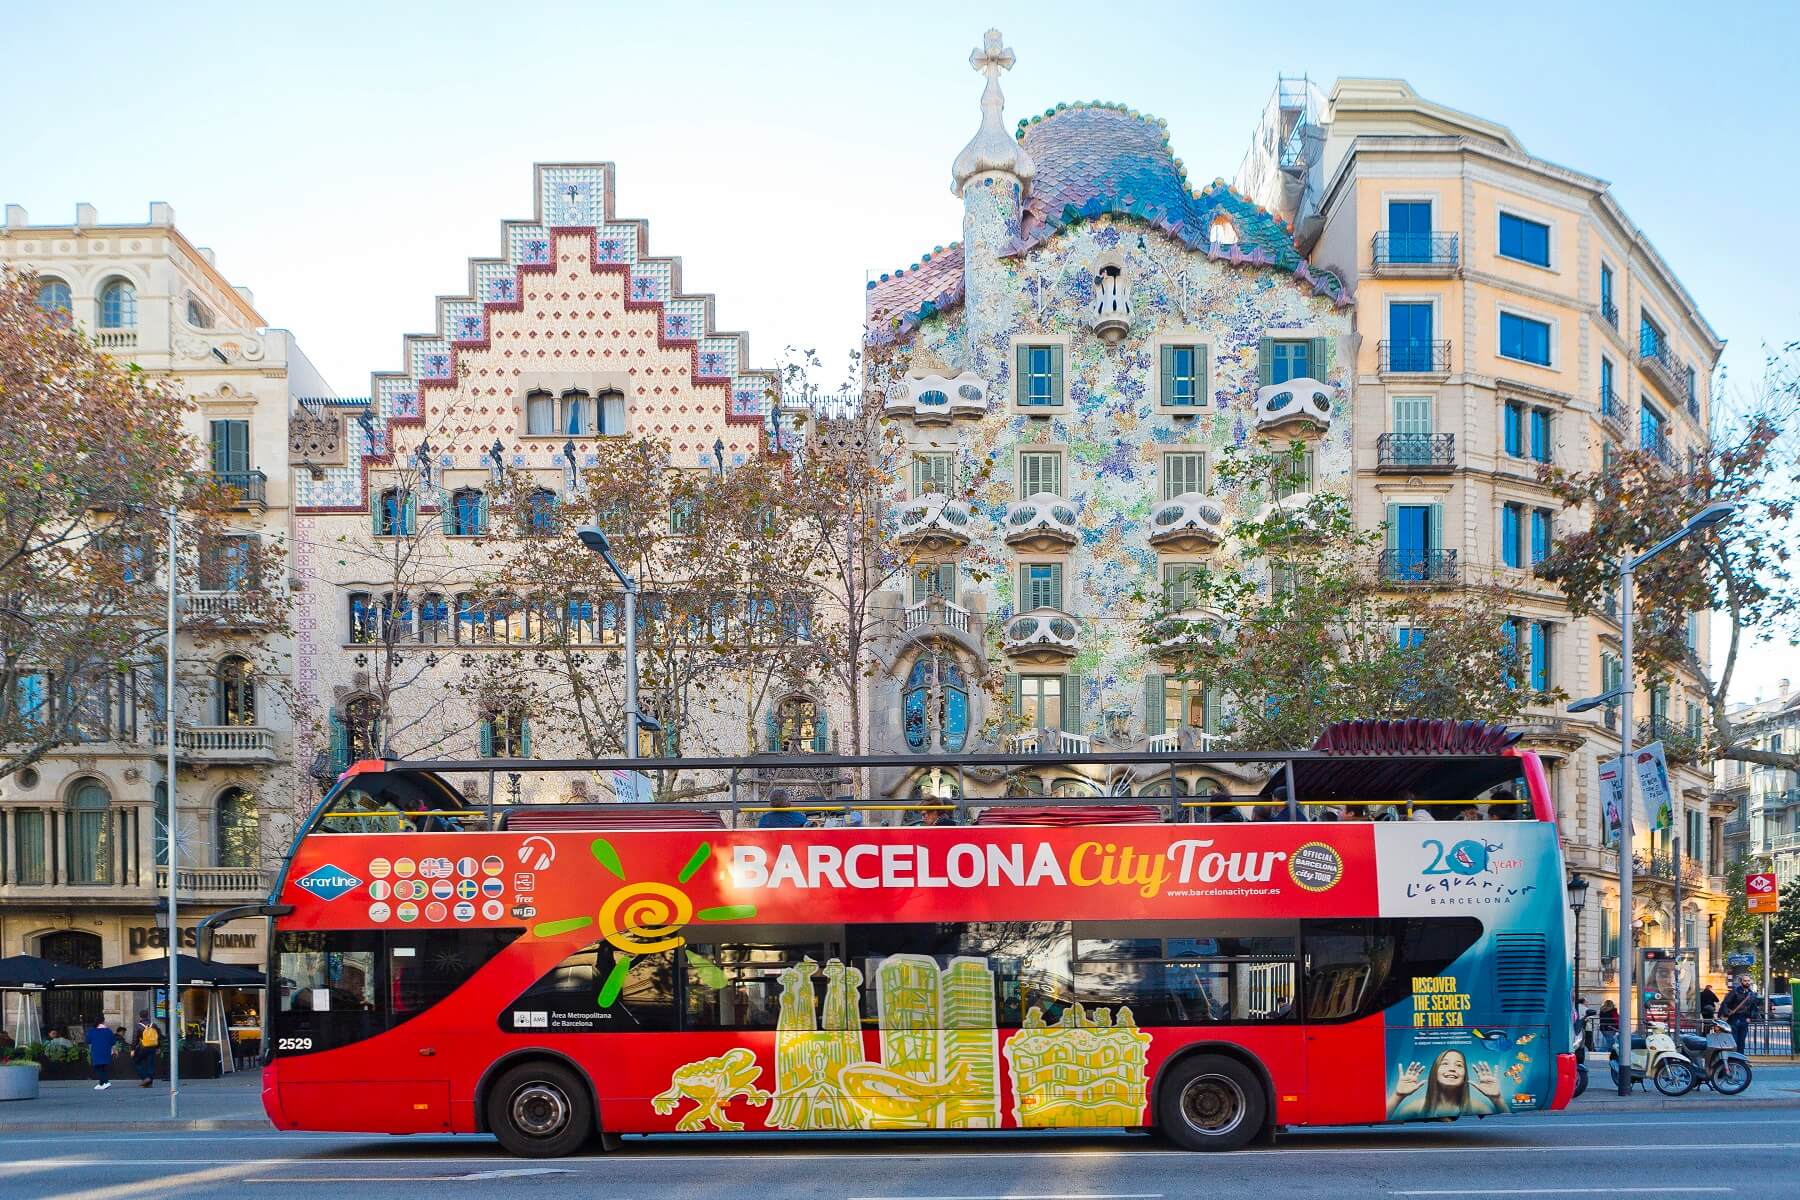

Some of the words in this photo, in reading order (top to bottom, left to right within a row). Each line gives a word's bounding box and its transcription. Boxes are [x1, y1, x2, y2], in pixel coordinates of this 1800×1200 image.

[1302, 849, 1333, 862] OFFICIAL
[733, 843, 1067, 888] BARCELONA
[1069, 841, 1170, 898] City
[1167, 839, 1287, 884] Tour
[1295, 858, 1337, 873] BARCELONA
[1314, 871, 1331, 883] TOUR
[1166, 887, 1281, 897] www.barcelonacitytour.es
[1430, 897, 1511, 905] BARCELONA
[214, 933, 257, 949] COMPANY
[1412, 976, 1457, 993] DISCOVER
[1412, 994, 1431, 1011] THE
[1431, 993, 1472, 1011] SECRETS
[1413, 1012, 1426, 1028] OF
[1427, 1012, 1445, 1028] THE
[1445, 1011, 1464, 1028] SEA
[278, 1038, 312, 1050] 2529
